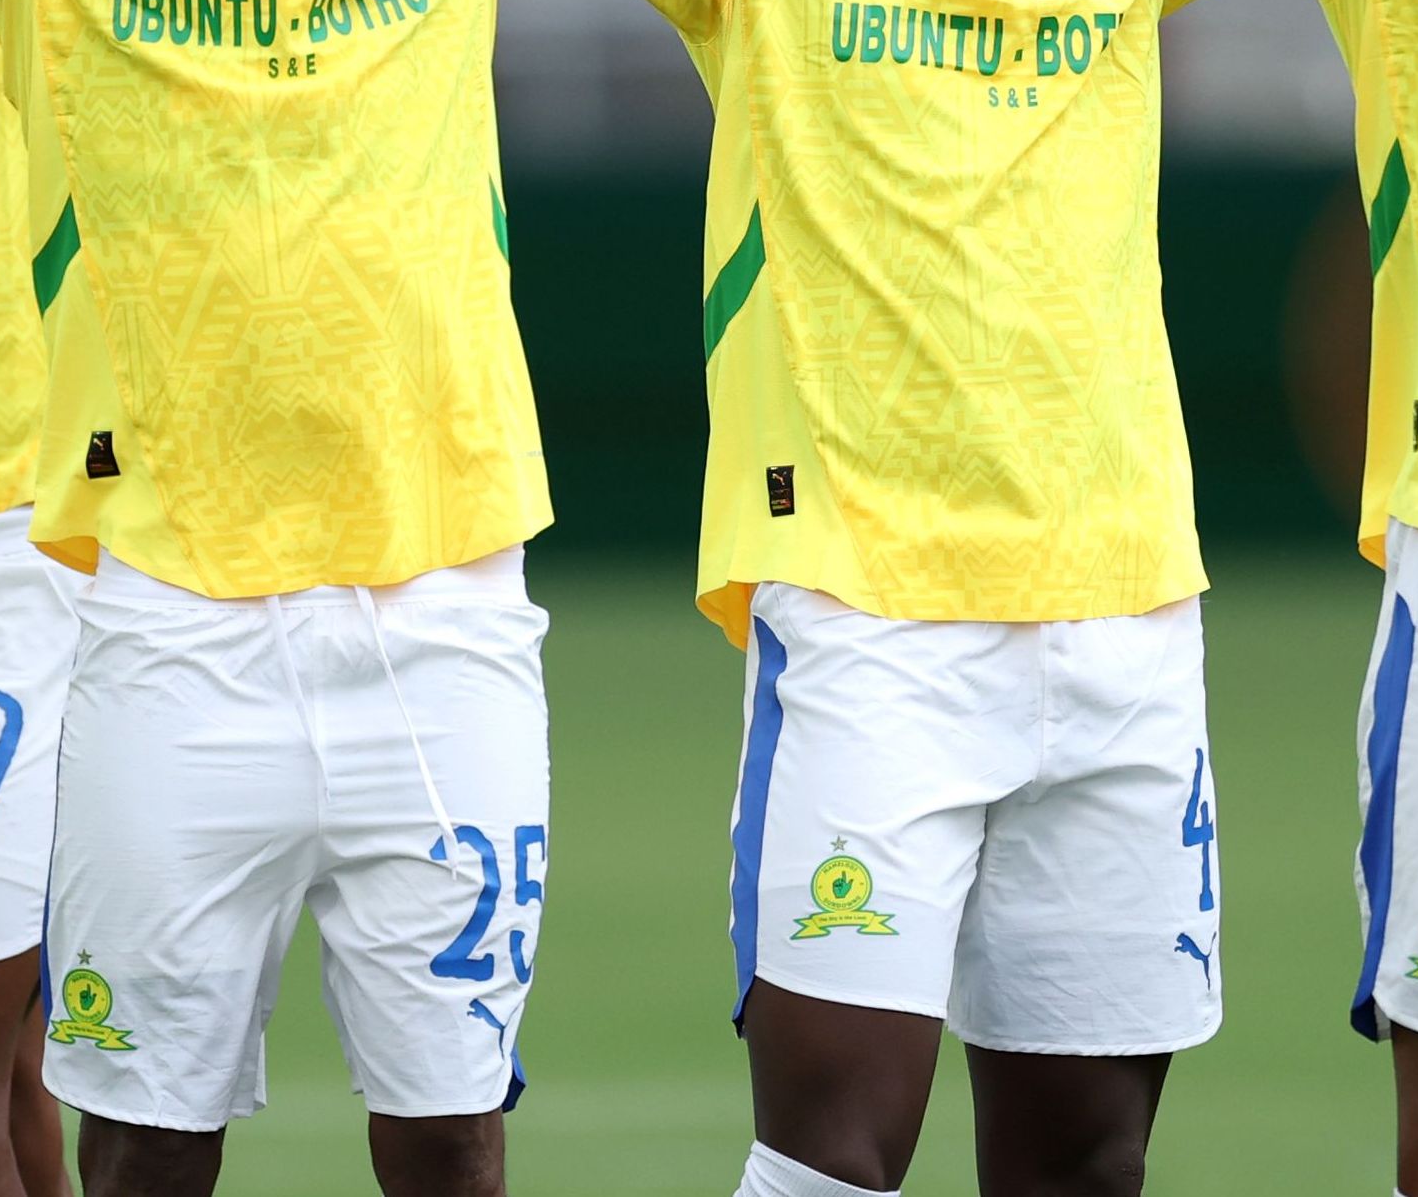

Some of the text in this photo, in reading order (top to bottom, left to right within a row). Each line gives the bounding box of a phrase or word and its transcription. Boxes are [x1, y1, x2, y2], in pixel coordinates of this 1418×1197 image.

[268, 53, 317, 78] S & E
[832, 2, 1004, 76] UBUNTU
[1036, 12, 1124, 77] BOT
[988, 87, 1038, 108] S & E
[1182, 747, 1214, 912] 4
[429, 825, 545, 984] 25
